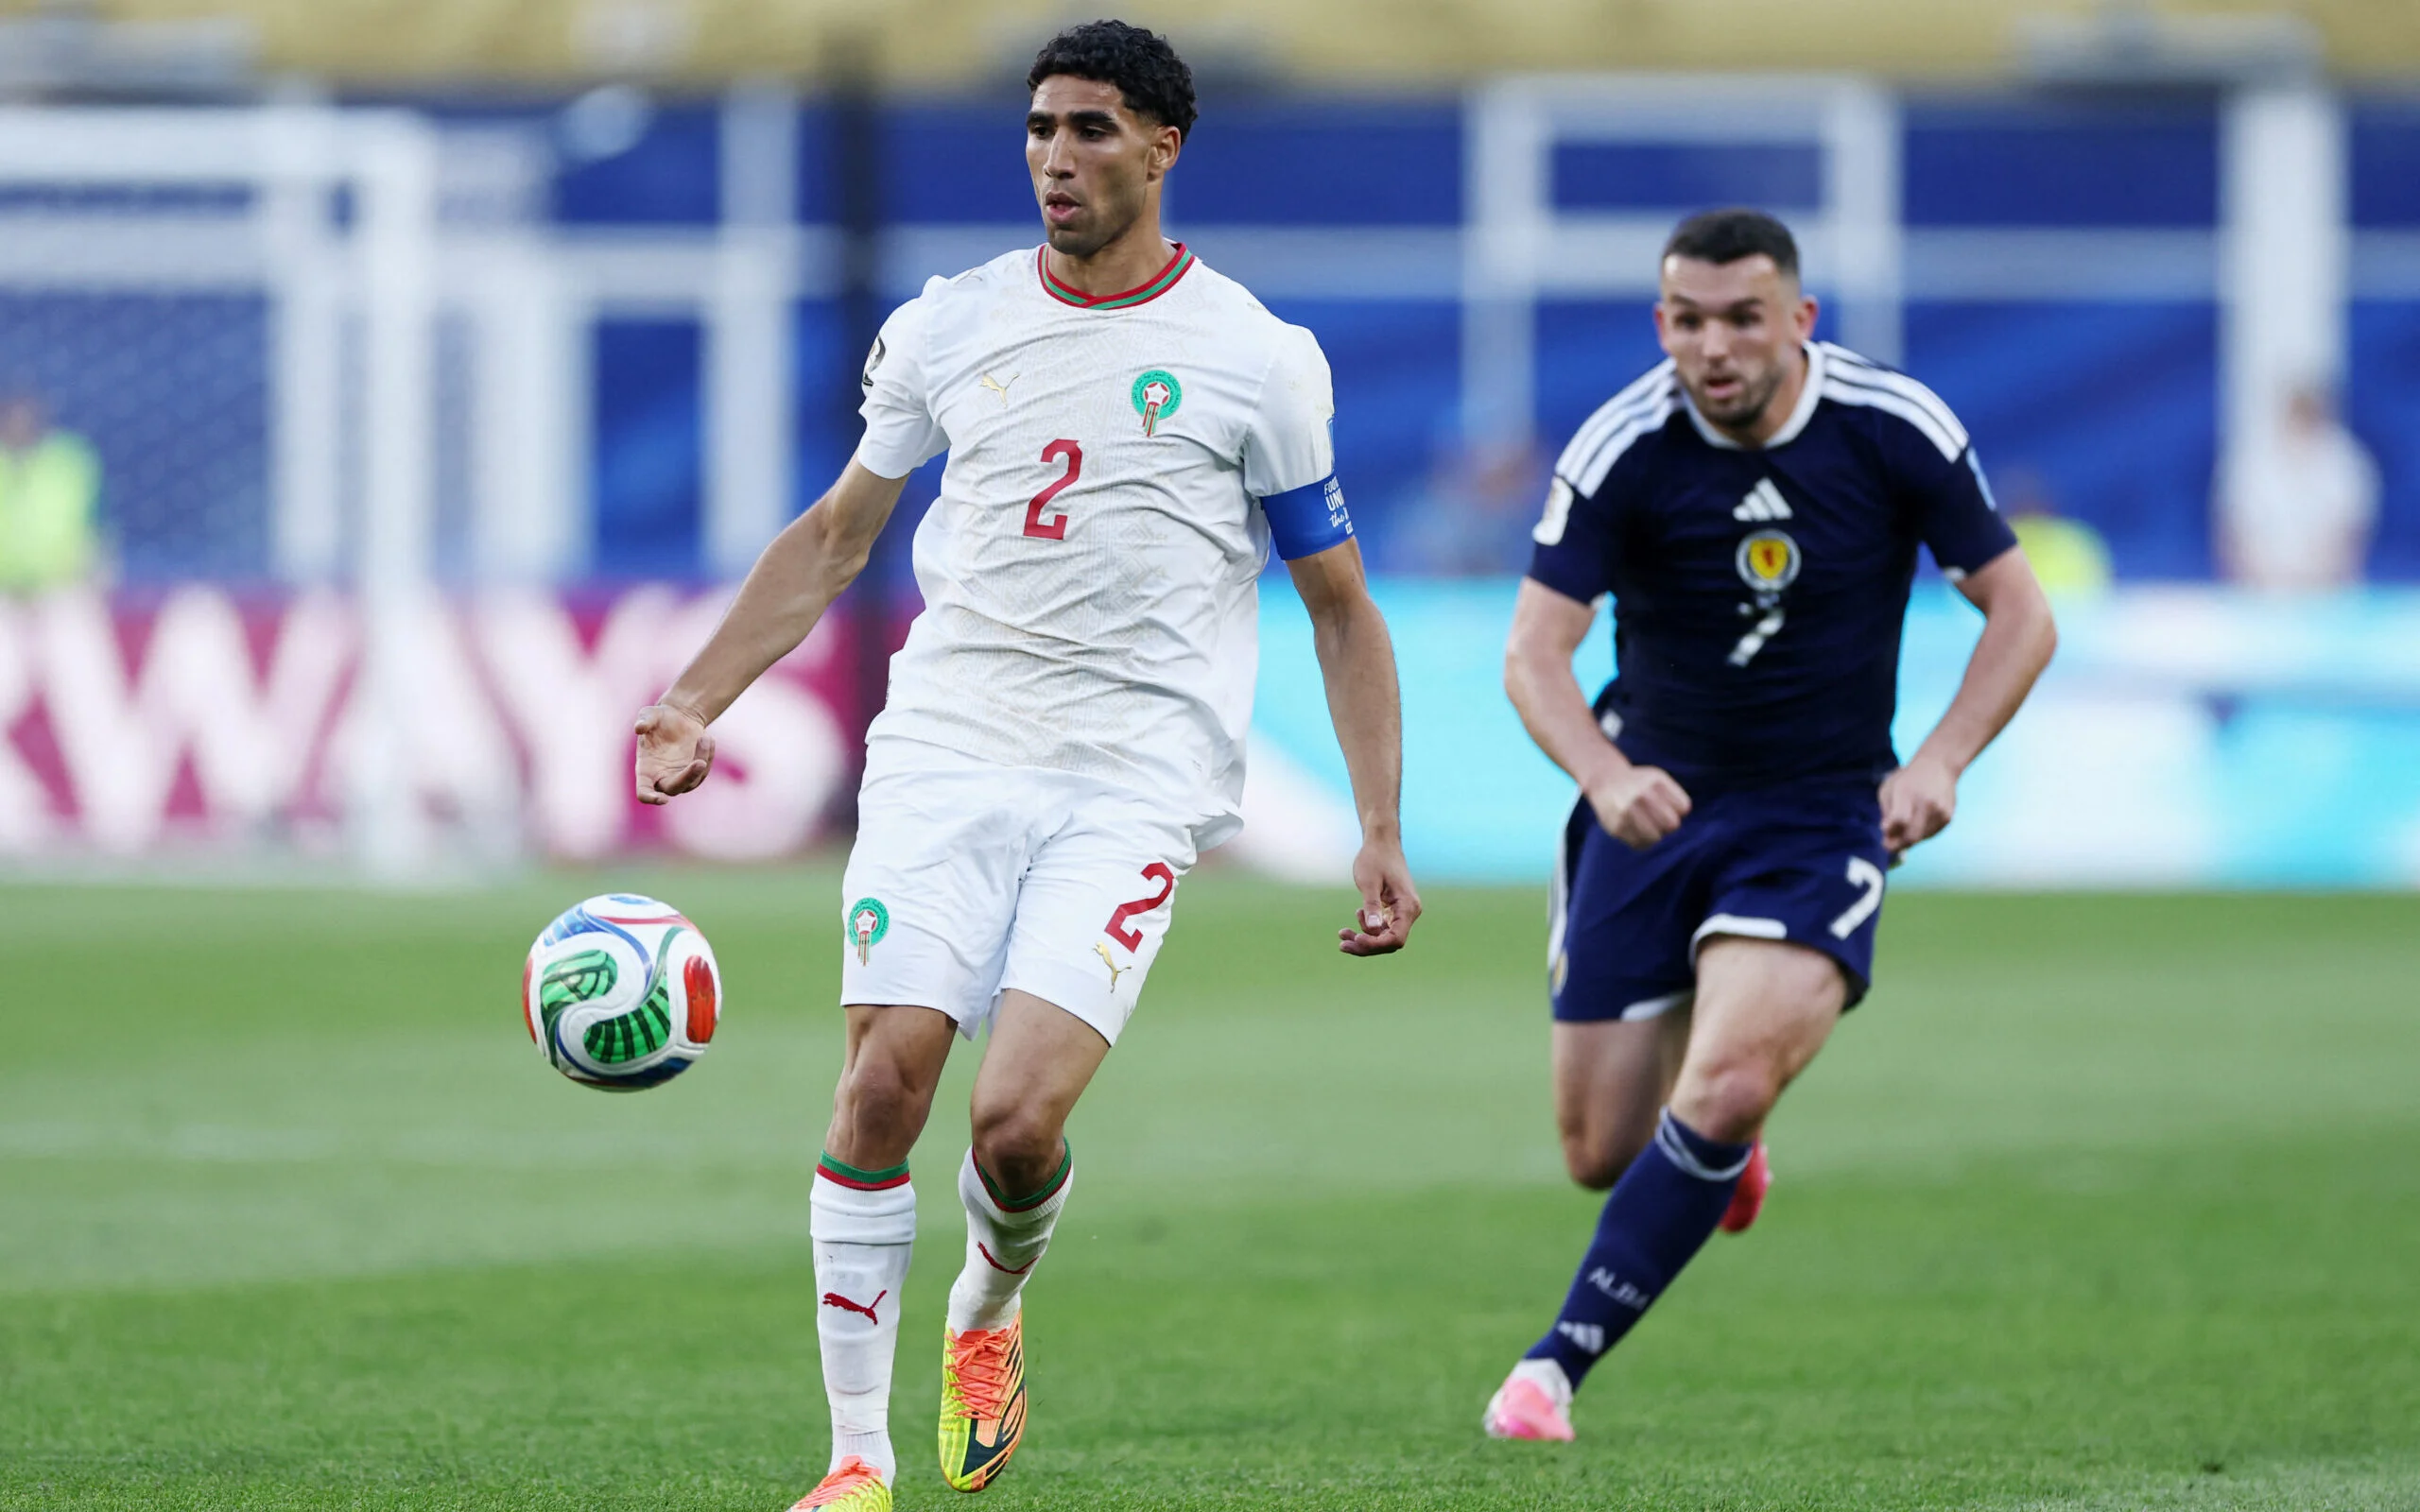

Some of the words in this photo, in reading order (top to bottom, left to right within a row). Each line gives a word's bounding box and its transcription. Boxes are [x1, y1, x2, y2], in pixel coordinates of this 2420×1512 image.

[1023, 438, 1082, 541] 2
[1104, 862, 1174, 954] 2
[1829, 856, 1884, 940] 7
